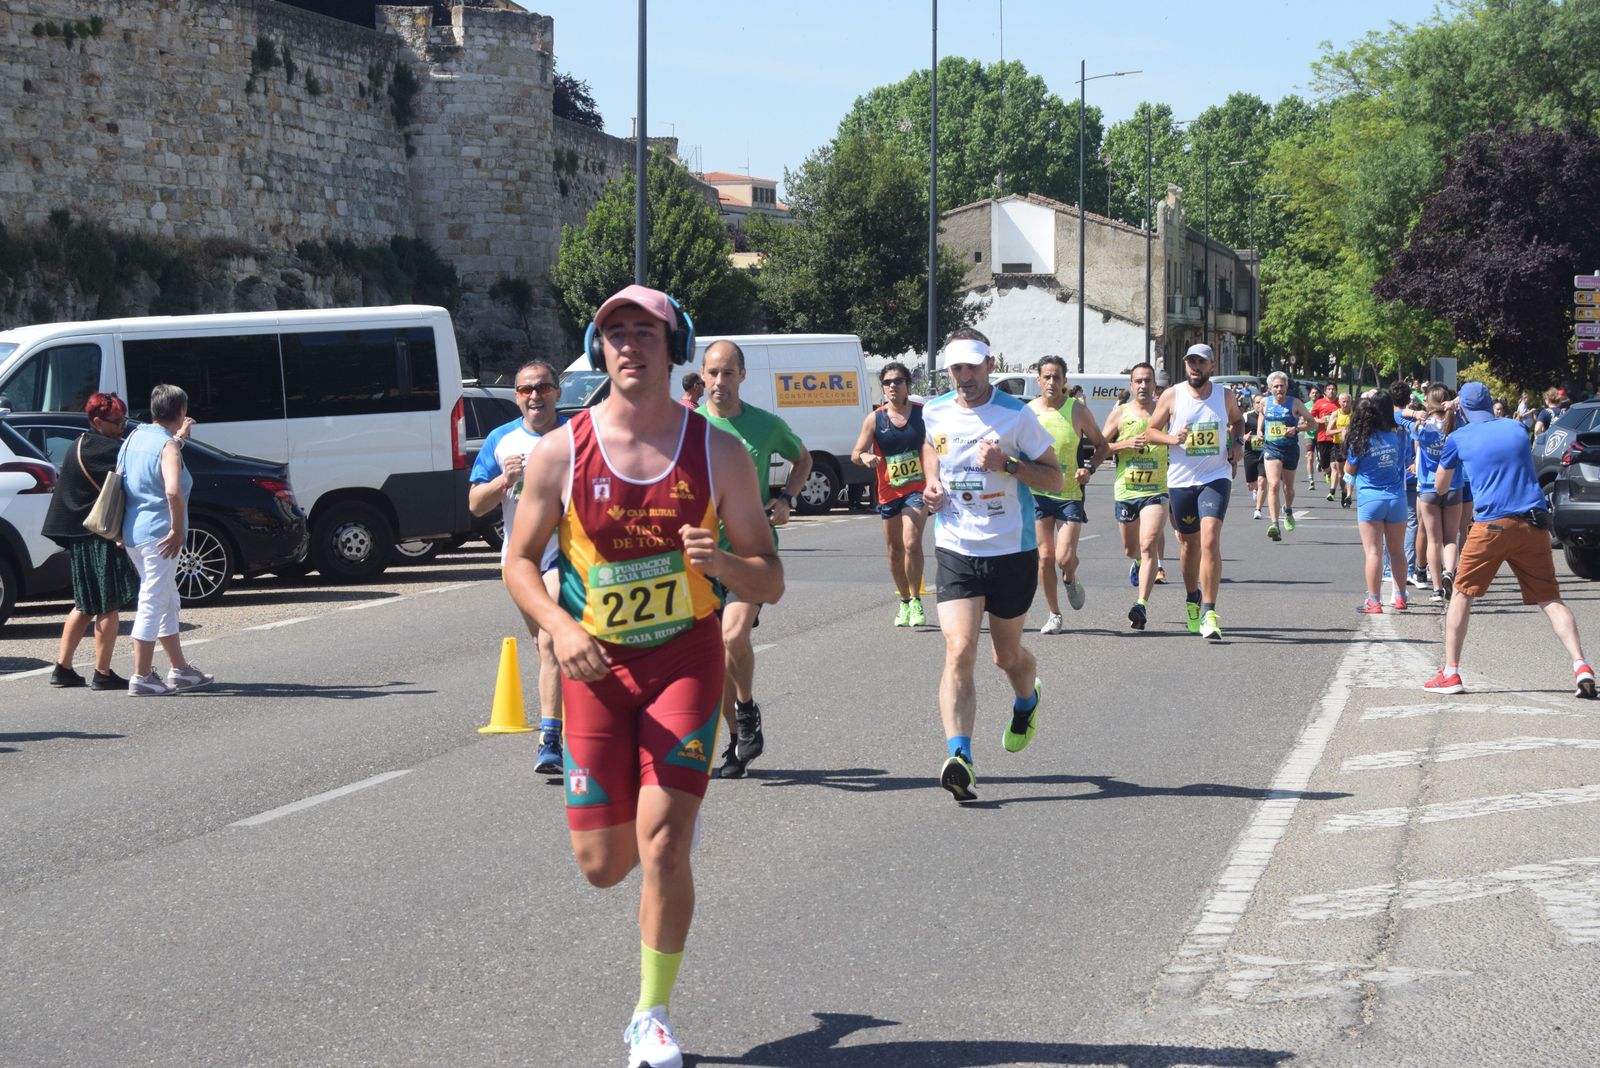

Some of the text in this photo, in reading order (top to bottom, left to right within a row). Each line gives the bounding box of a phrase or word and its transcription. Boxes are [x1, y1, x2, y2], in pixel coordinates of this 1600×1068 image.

[1190, 431, 1215, 447] 132
[891, 460, 919, 478] 202
[1129, 470, 1153, 483] 177
[626, 507, 678, 517] CAJA RURAL
[624, 524, 662, 536] VINO
[612, 538, 633, 549] DE
[616, 565, 673, 584] CAJA RURAL
[602, 579, 677, 628] 227
[626, 632, 653, 644] CAJA
